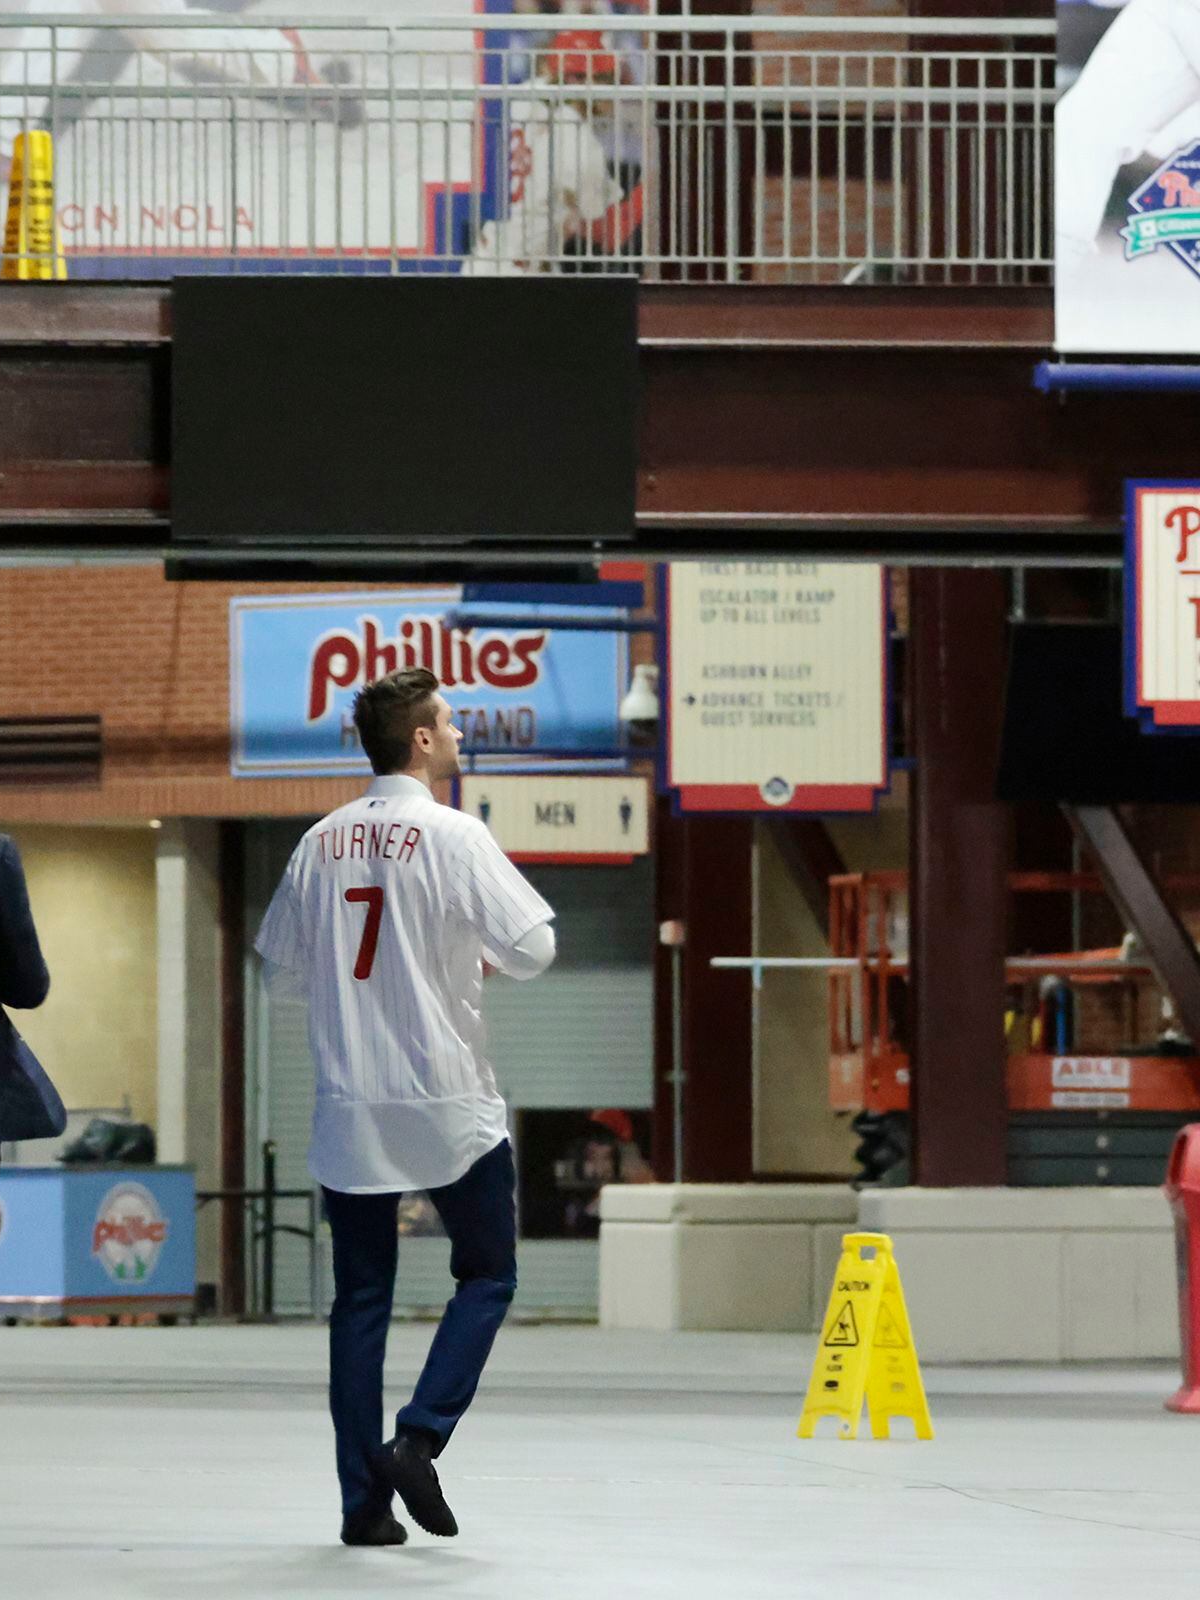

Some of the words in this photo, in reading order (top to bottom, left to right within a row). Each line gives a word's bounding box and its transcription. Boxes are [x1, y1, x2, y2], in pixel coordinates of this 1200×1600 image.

[141, 204, 255, 231] NOLA
[455, 708, 537, 748] TAND
[534, 801, 576, 827] MEN
[318, 822, 421, 865] TURNER
[344, 886, 384, 981] 7
